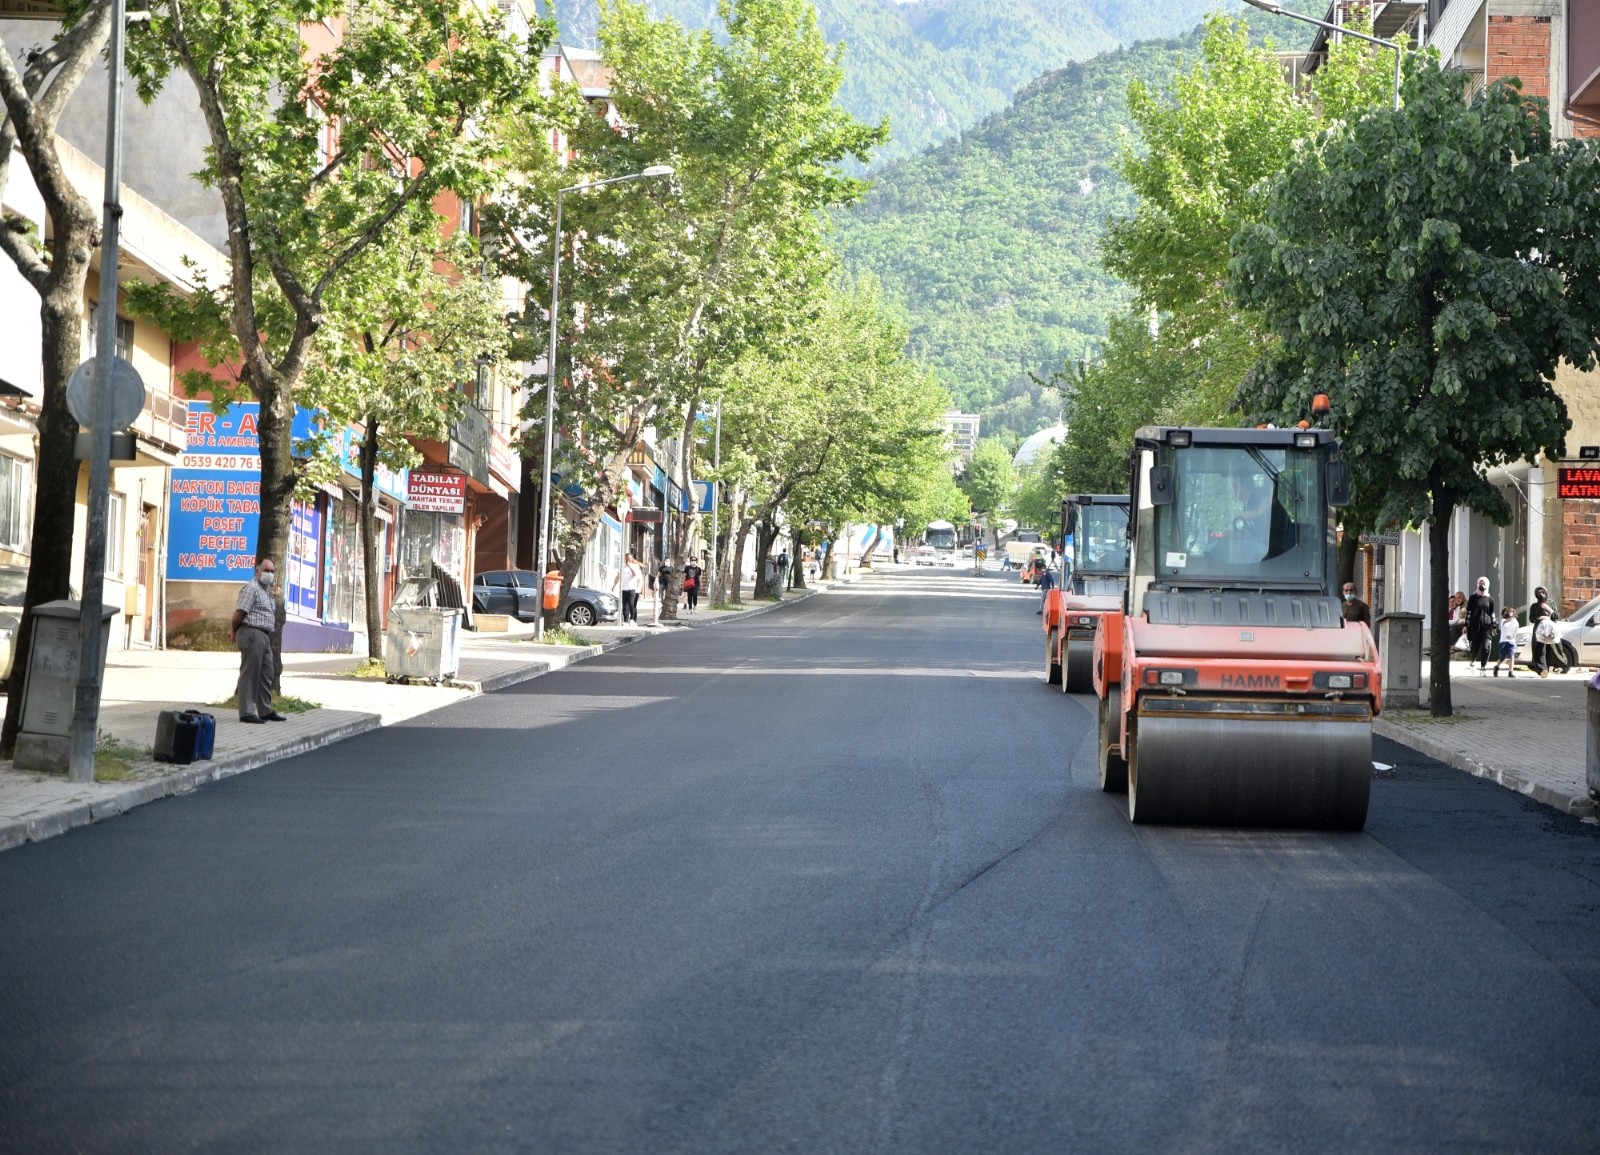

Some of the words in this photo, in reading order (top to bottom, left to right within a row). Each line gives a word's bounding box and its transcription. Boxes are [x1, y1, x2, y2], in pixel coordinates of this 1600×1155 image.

[207, 435, 216, 446] &
[183, 456, 212, 468] 0539
[214, 457, 237, 468] 420
[240, 457, 253, 469] 76
[172, 480, 224, 494] KARTON
[410, 484, 461, 496] DÜNYASI
[1561, 484, 1600, 496] KATM
[181, 495, 223, 512] KÖPÜK
[203, 517, 244, 534] POŞET
[199, 535, 247, 552] PEÇETE
[179, 553, 217, 570] KAŞIK
[1220, 673, 1281, 688] HAMM
